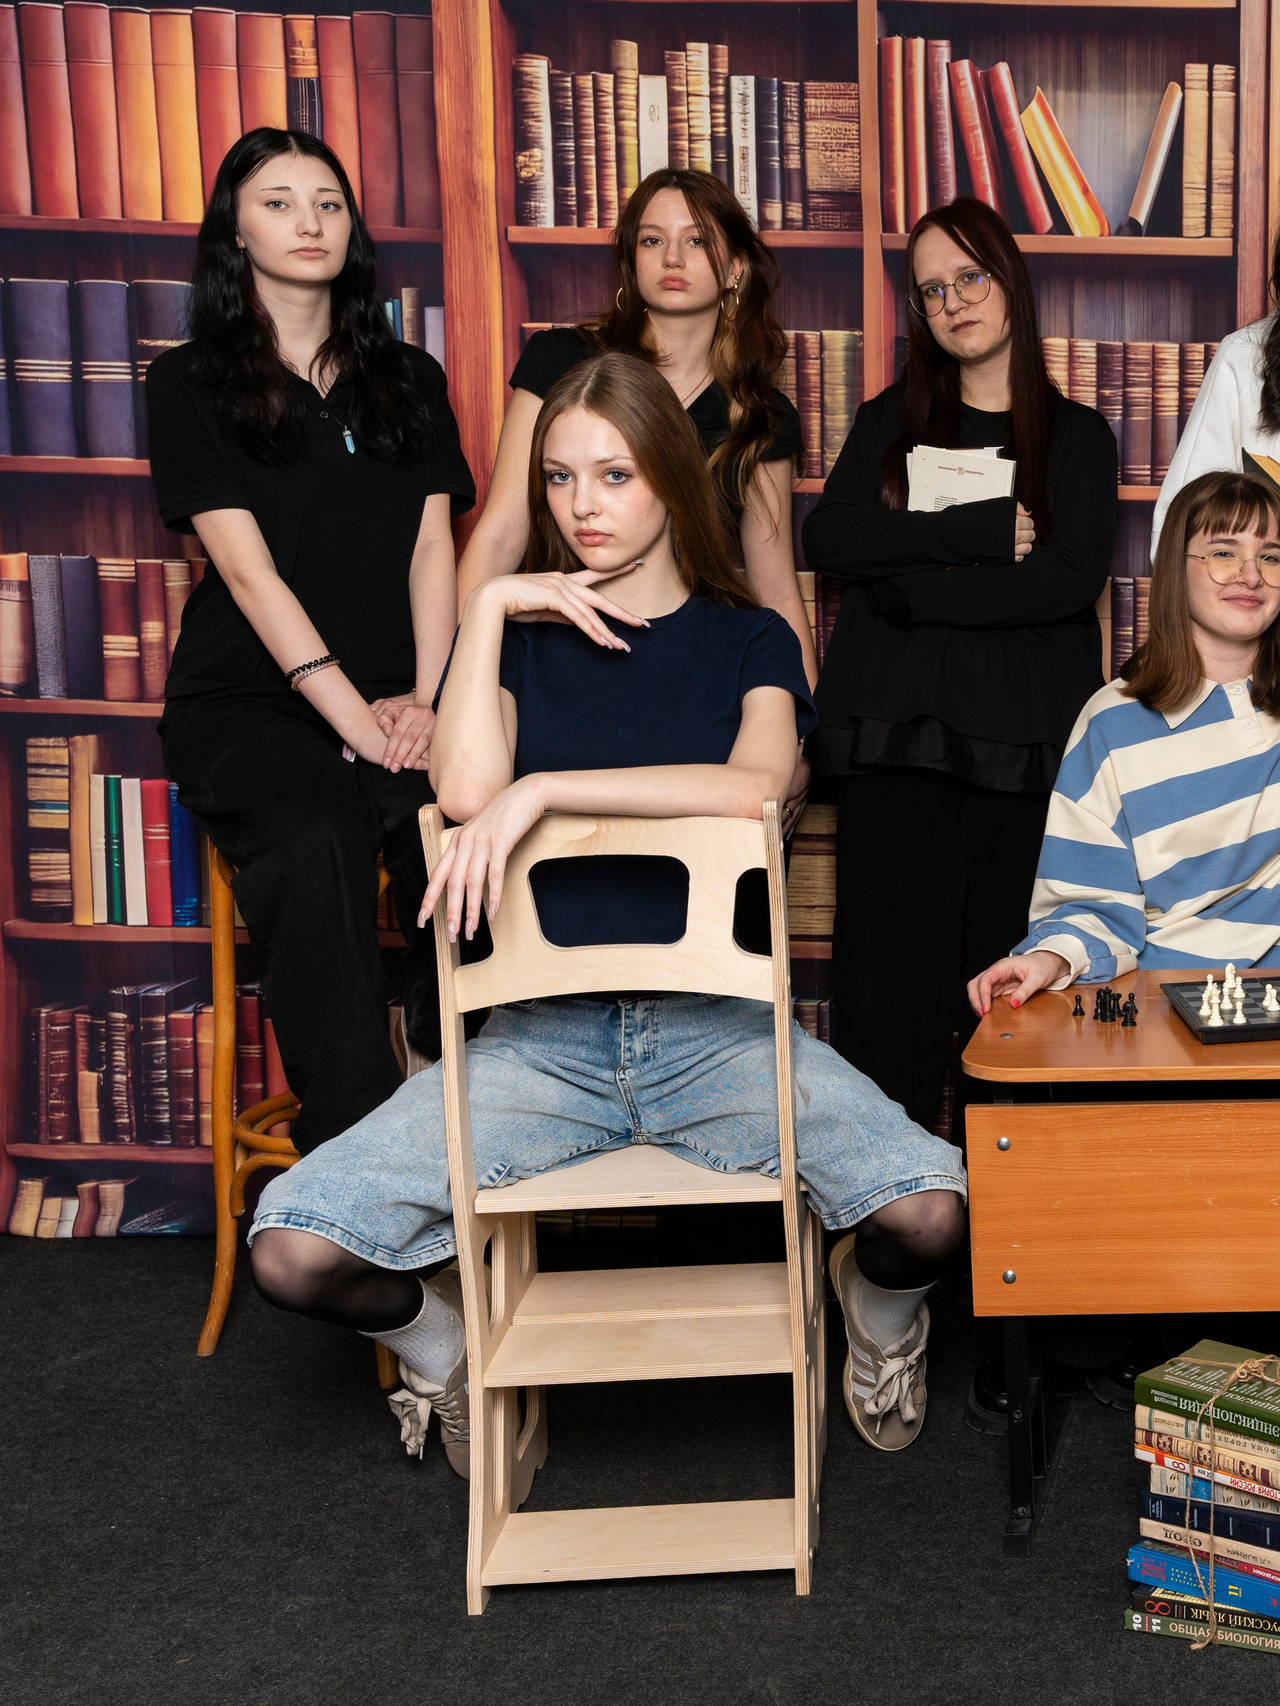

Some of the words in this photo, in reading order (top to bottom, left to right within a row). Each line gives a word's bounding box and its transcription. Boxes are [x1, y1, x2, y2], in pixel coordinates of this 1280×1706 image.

[1204, 1432, 1247, 1448] ГОРДЕВ
[1250, 1443, 1278, 1455] ФОМА
[1171, 1460, 1186, 1471] 8
[1229, 1477, 1256, 1494] РОССИИ
[1214, 1555, 1240, 1568] АЛГЕБР
[1228, 1584, 1239, 1597] 11
[1144, 1600, 1171, 1616] 8
[1190, 1607, 1225, 1623] ЯЫК
[1132, 1613, 1142, 1631] 10
[1151, 1617, 1162, 1632] 11
[1216, 1630, 1280, 1650] БИОЛОГИЯ
